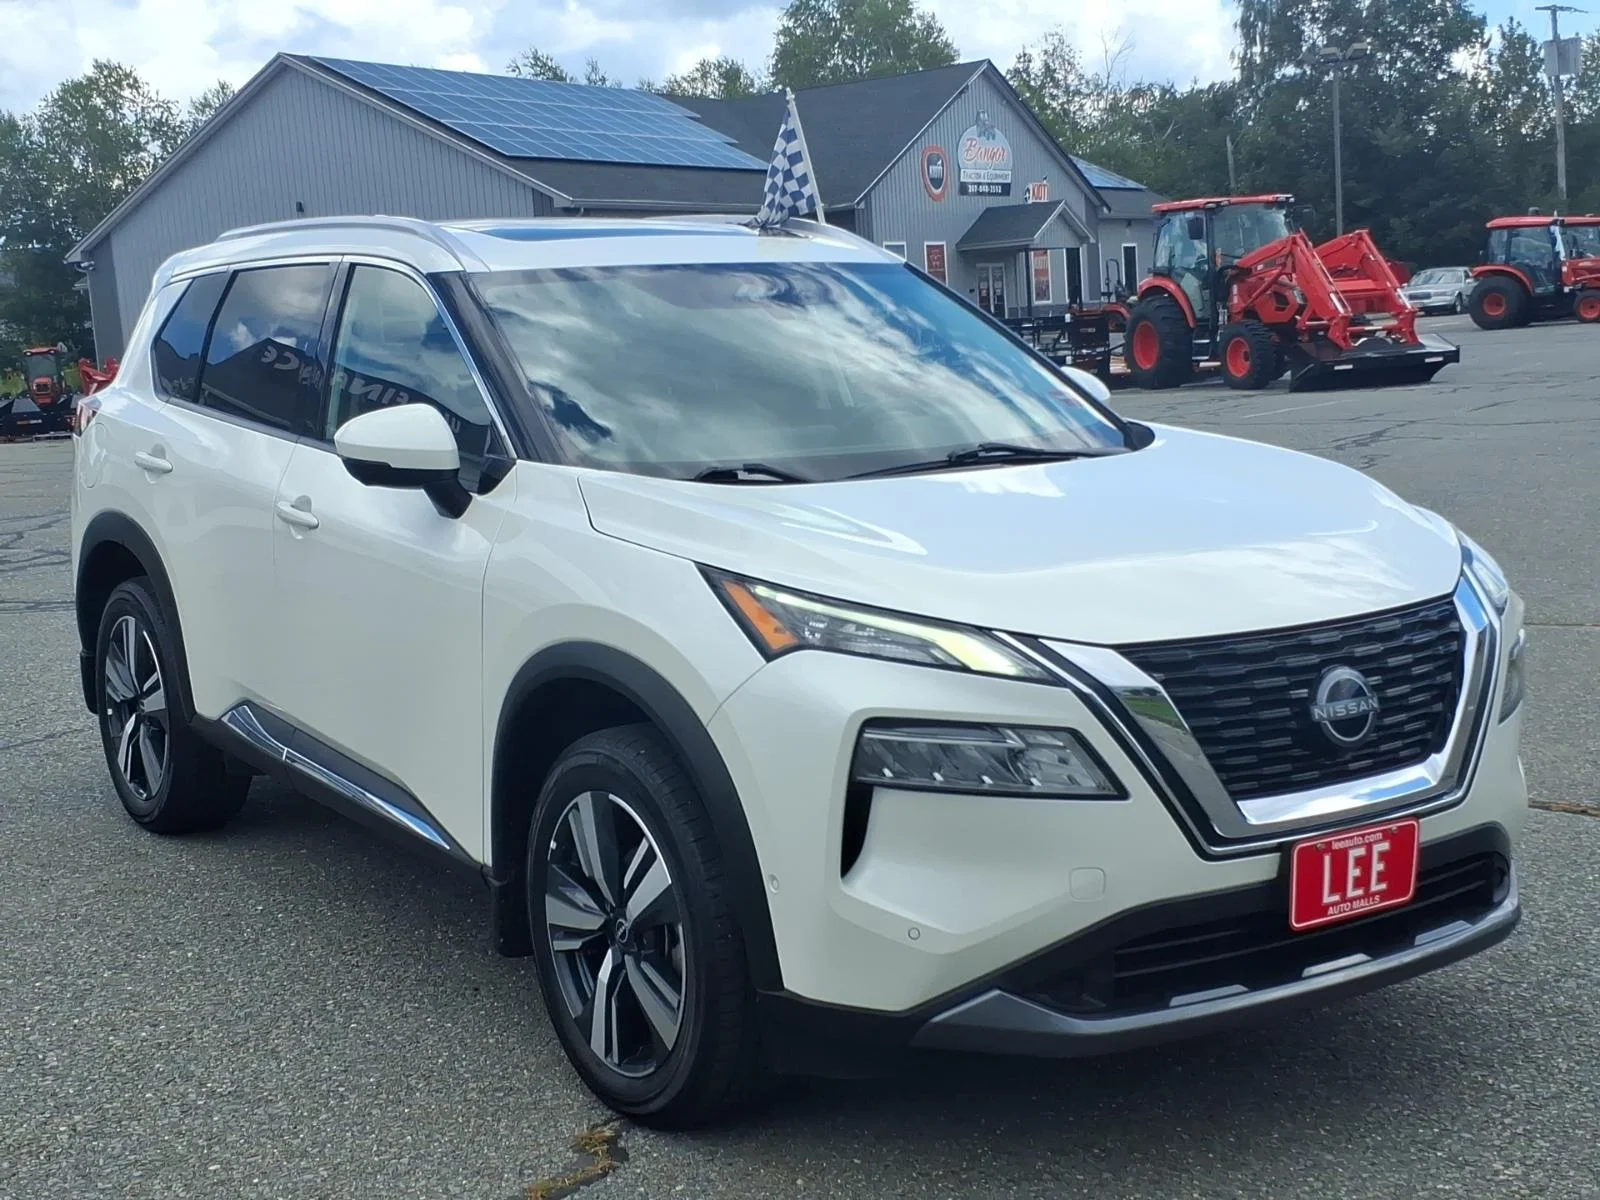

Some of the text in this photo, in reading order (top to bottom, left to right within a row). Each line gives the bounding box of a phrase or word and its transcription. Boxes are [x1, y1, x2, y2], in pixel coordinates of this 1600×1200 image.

[1313, 696, 1379, 720] NISSAN
[1331, 832, 1383, 850] leeauto.com
[1322, 841, 1391, 904] LEE
[1327, 895, 1381, 916] AUTO MALLS
